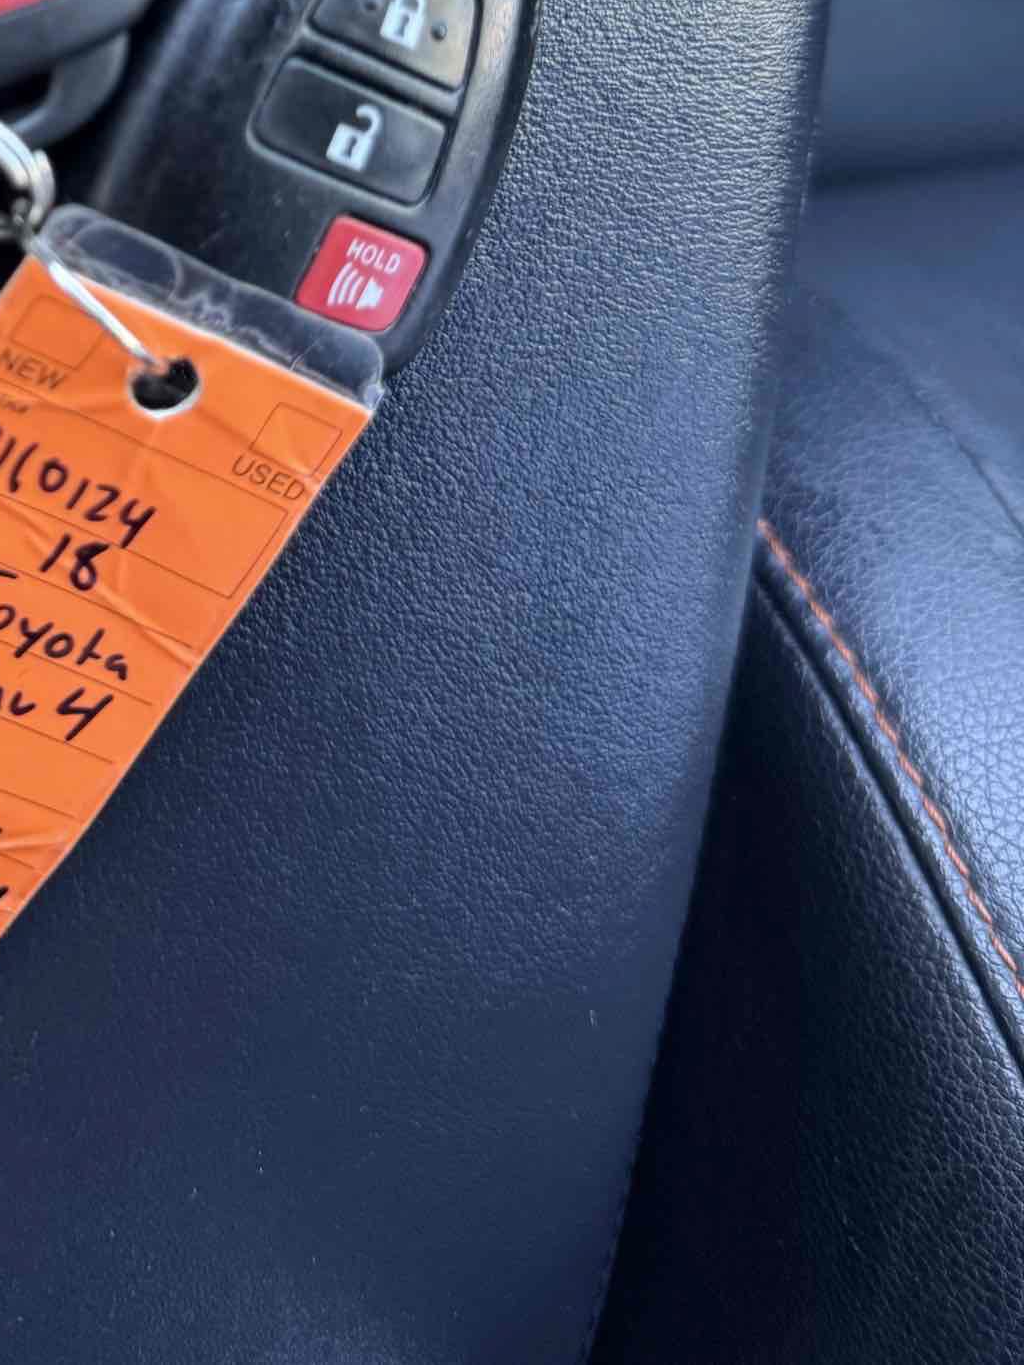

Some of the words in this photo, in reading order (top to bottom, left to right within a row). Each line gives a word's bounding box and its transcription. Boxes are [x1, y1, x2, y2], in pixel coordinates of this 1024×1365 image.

[346, 237, 401, 275] HOLD
[231, 455, 306, 502] USED
[39, 534, 110, 591] 18
